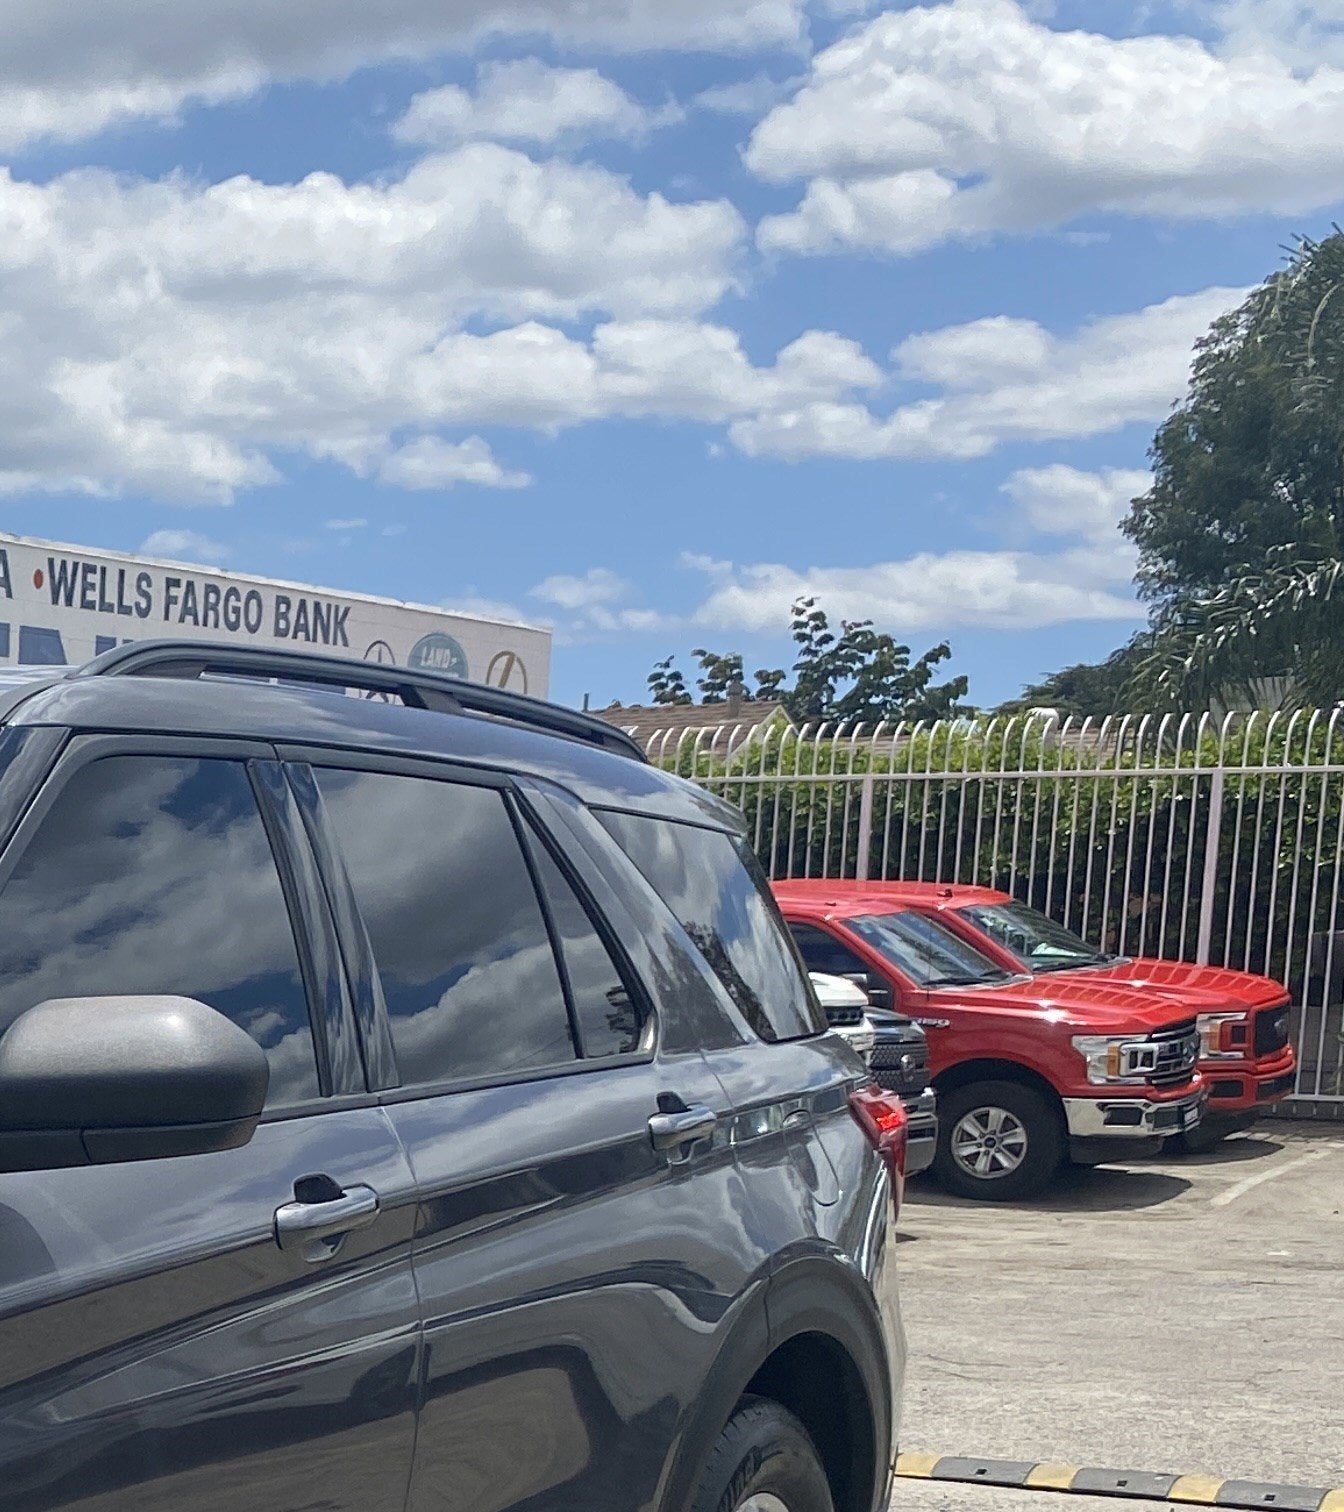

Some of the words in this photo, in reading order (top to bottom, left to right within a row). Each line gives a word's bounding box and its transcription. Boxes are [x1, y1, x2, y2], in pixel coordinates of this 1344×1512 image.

[46, 556, 153, 620] WELLS
[162, 576, 263, 635] FARGO
[272, 597, 352, 648] BANK
